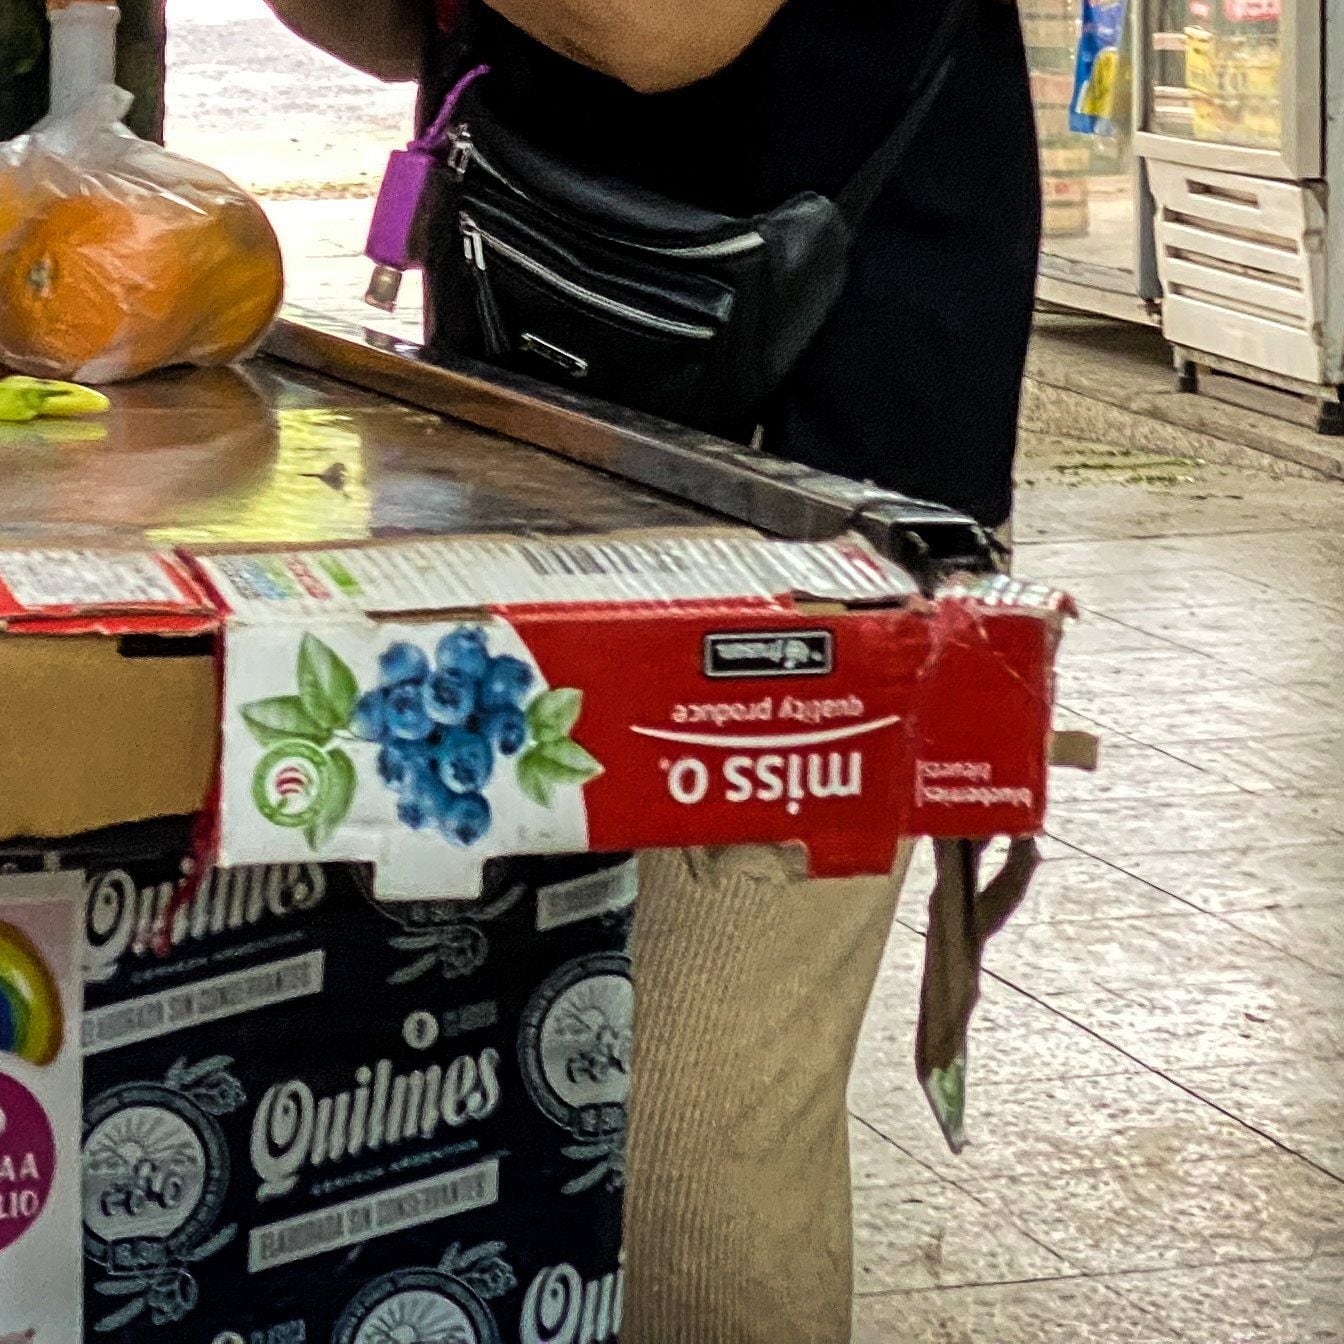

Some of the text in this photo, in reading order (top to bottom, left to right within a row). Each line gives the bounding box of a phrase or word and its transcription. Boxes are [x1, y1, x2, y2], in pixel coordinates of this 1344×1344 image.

[671, 693, 865, 727] quality produce
[722, 750, 864, 817] miss
[249, 1047, 501, 1202] Quilmes
[19, 1152, 39, 1179] A
